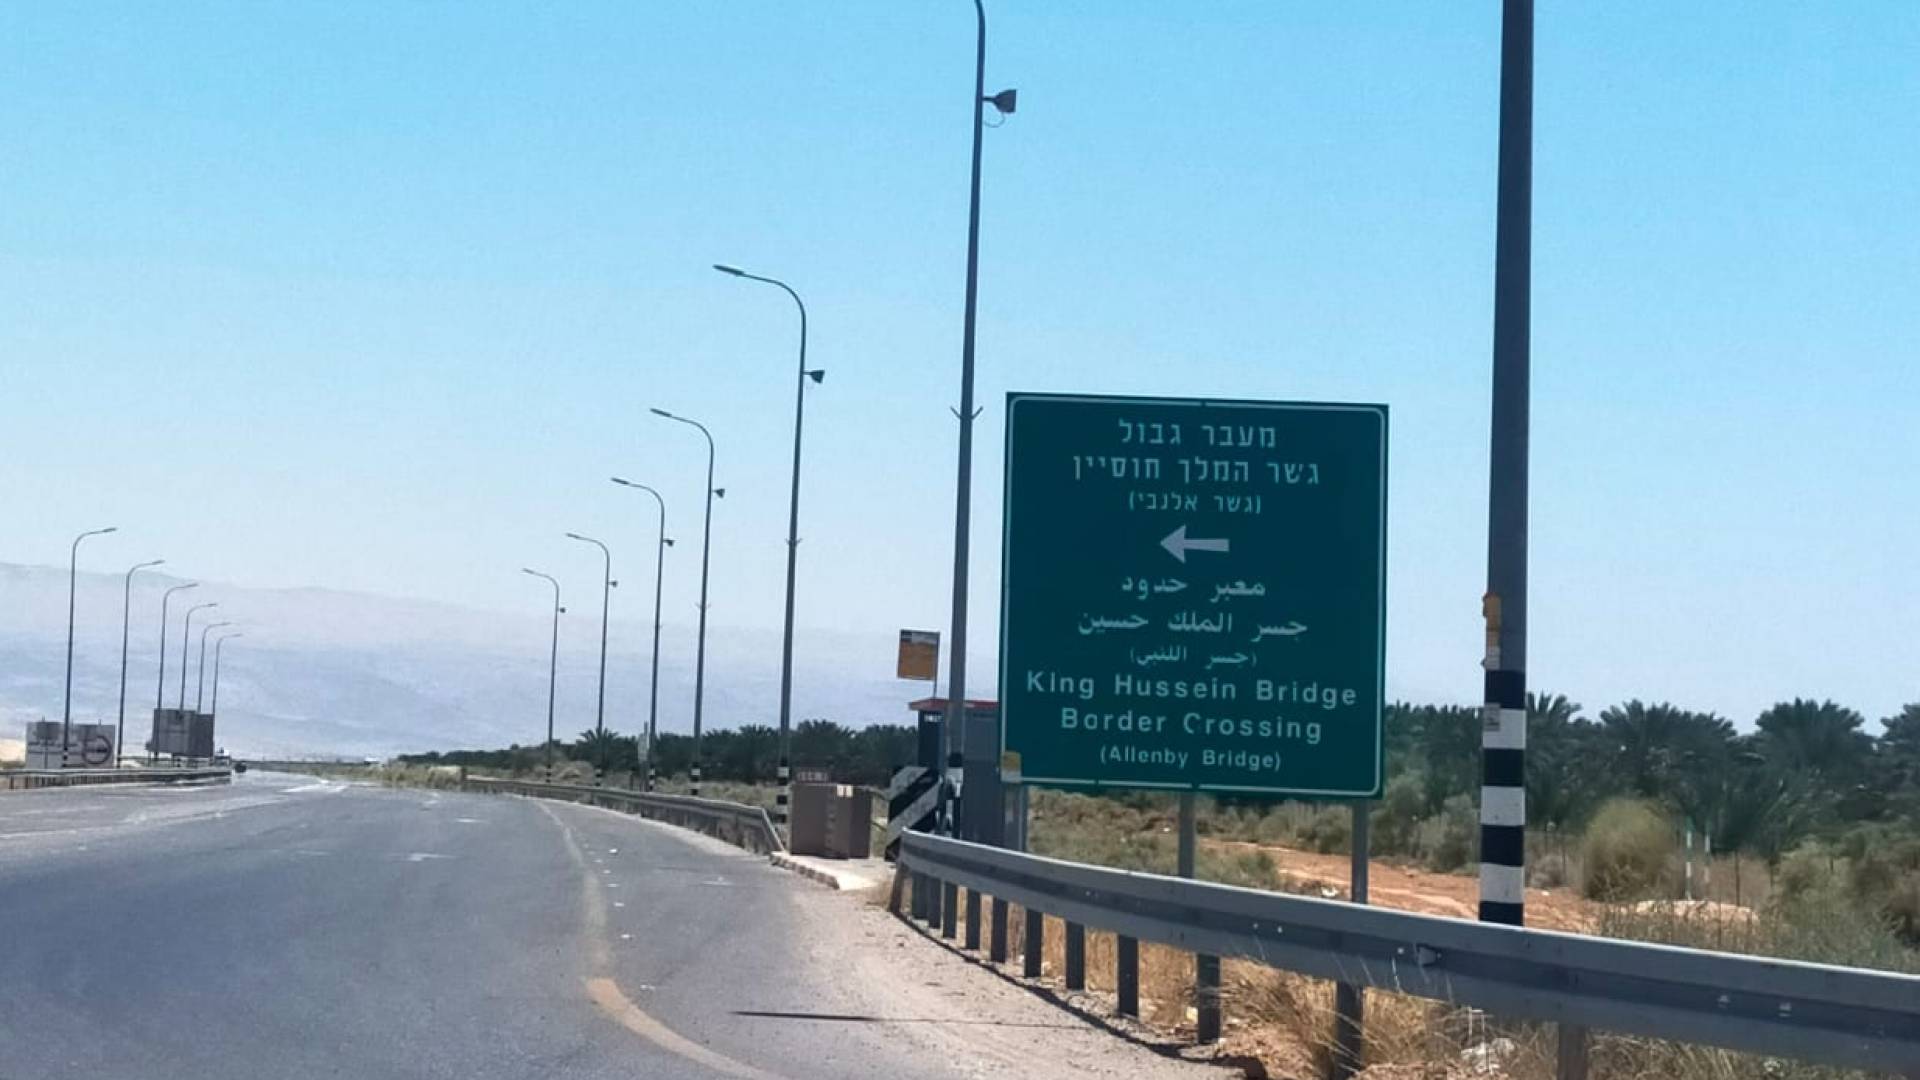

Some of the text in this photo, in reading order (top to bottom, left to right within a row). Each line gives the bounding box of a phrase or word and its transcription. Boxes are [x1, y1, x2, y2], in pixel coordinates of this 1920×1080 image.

[1119, 418, 1276, 448] מעבר גבול
[1073, 455, 1160, 480] חוסיין
[1178, 457, 1249, 483] המלך
[1122, 575, 1266, 602] معبر حدود
[1078, 611, 1308, 642] جسر الملك حسين
[1027, 670, 1357, 710] King Hussein Bridge
[1061, 707, 1322, 744] Border Crossing
[1100, 746, 1281, 771] (Allenby Bridge)
